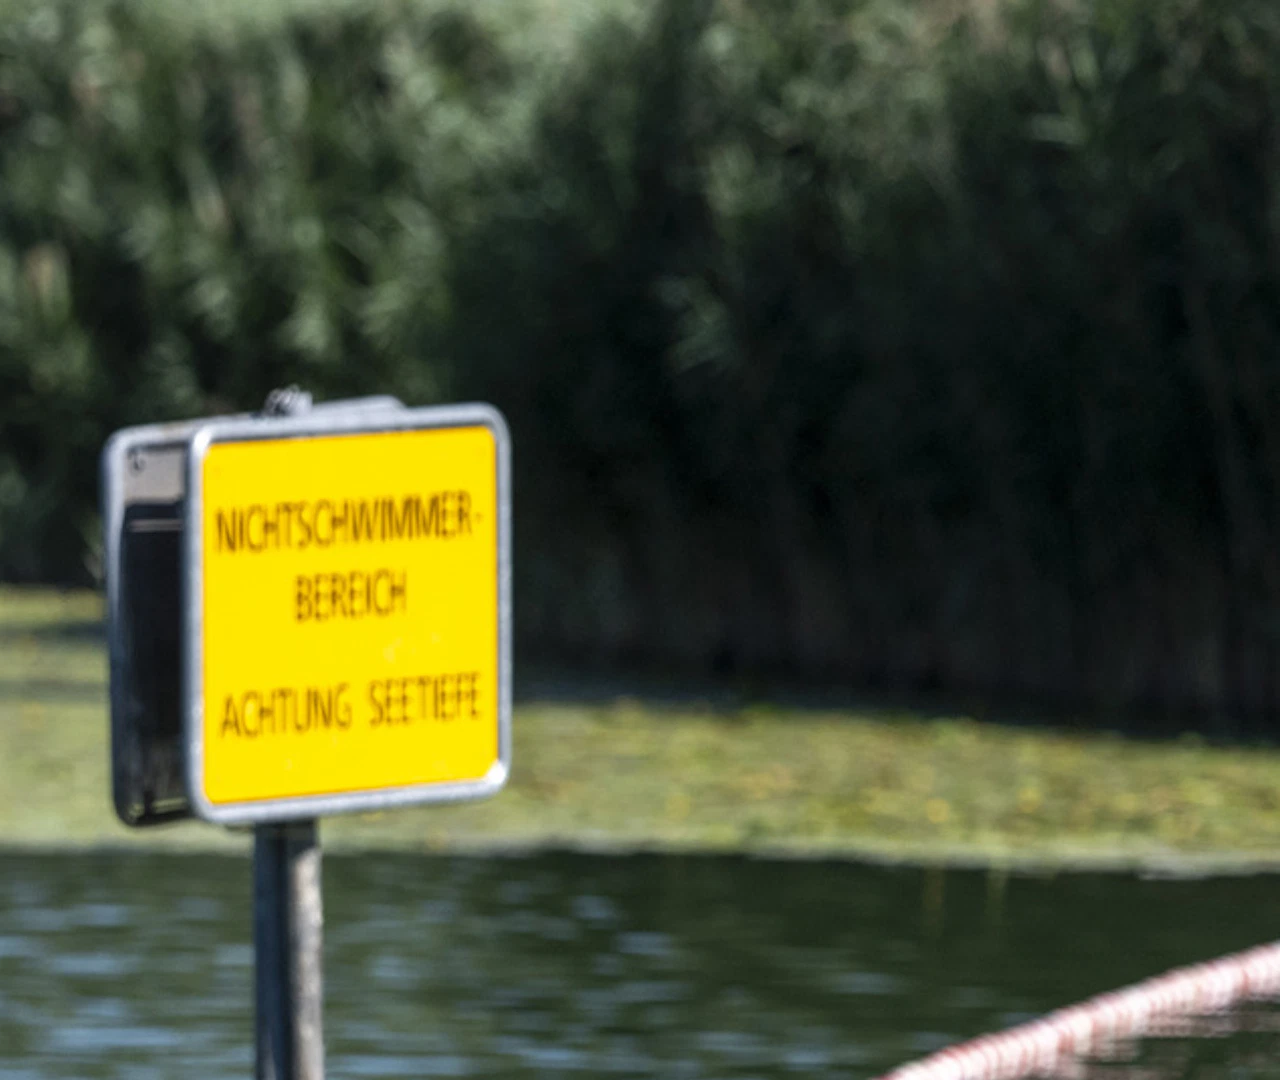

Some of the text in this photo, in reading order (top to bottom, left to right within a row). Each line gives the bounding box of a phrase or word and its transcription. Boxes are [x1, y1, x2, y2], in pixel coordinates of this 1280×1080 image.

[216, 491, 483, 552] NICHTSCHWIMMER-
[295, 568, 407, 622] BEREICH
[219, 672, 480, 738] ACHTUNG SEETIEFE
